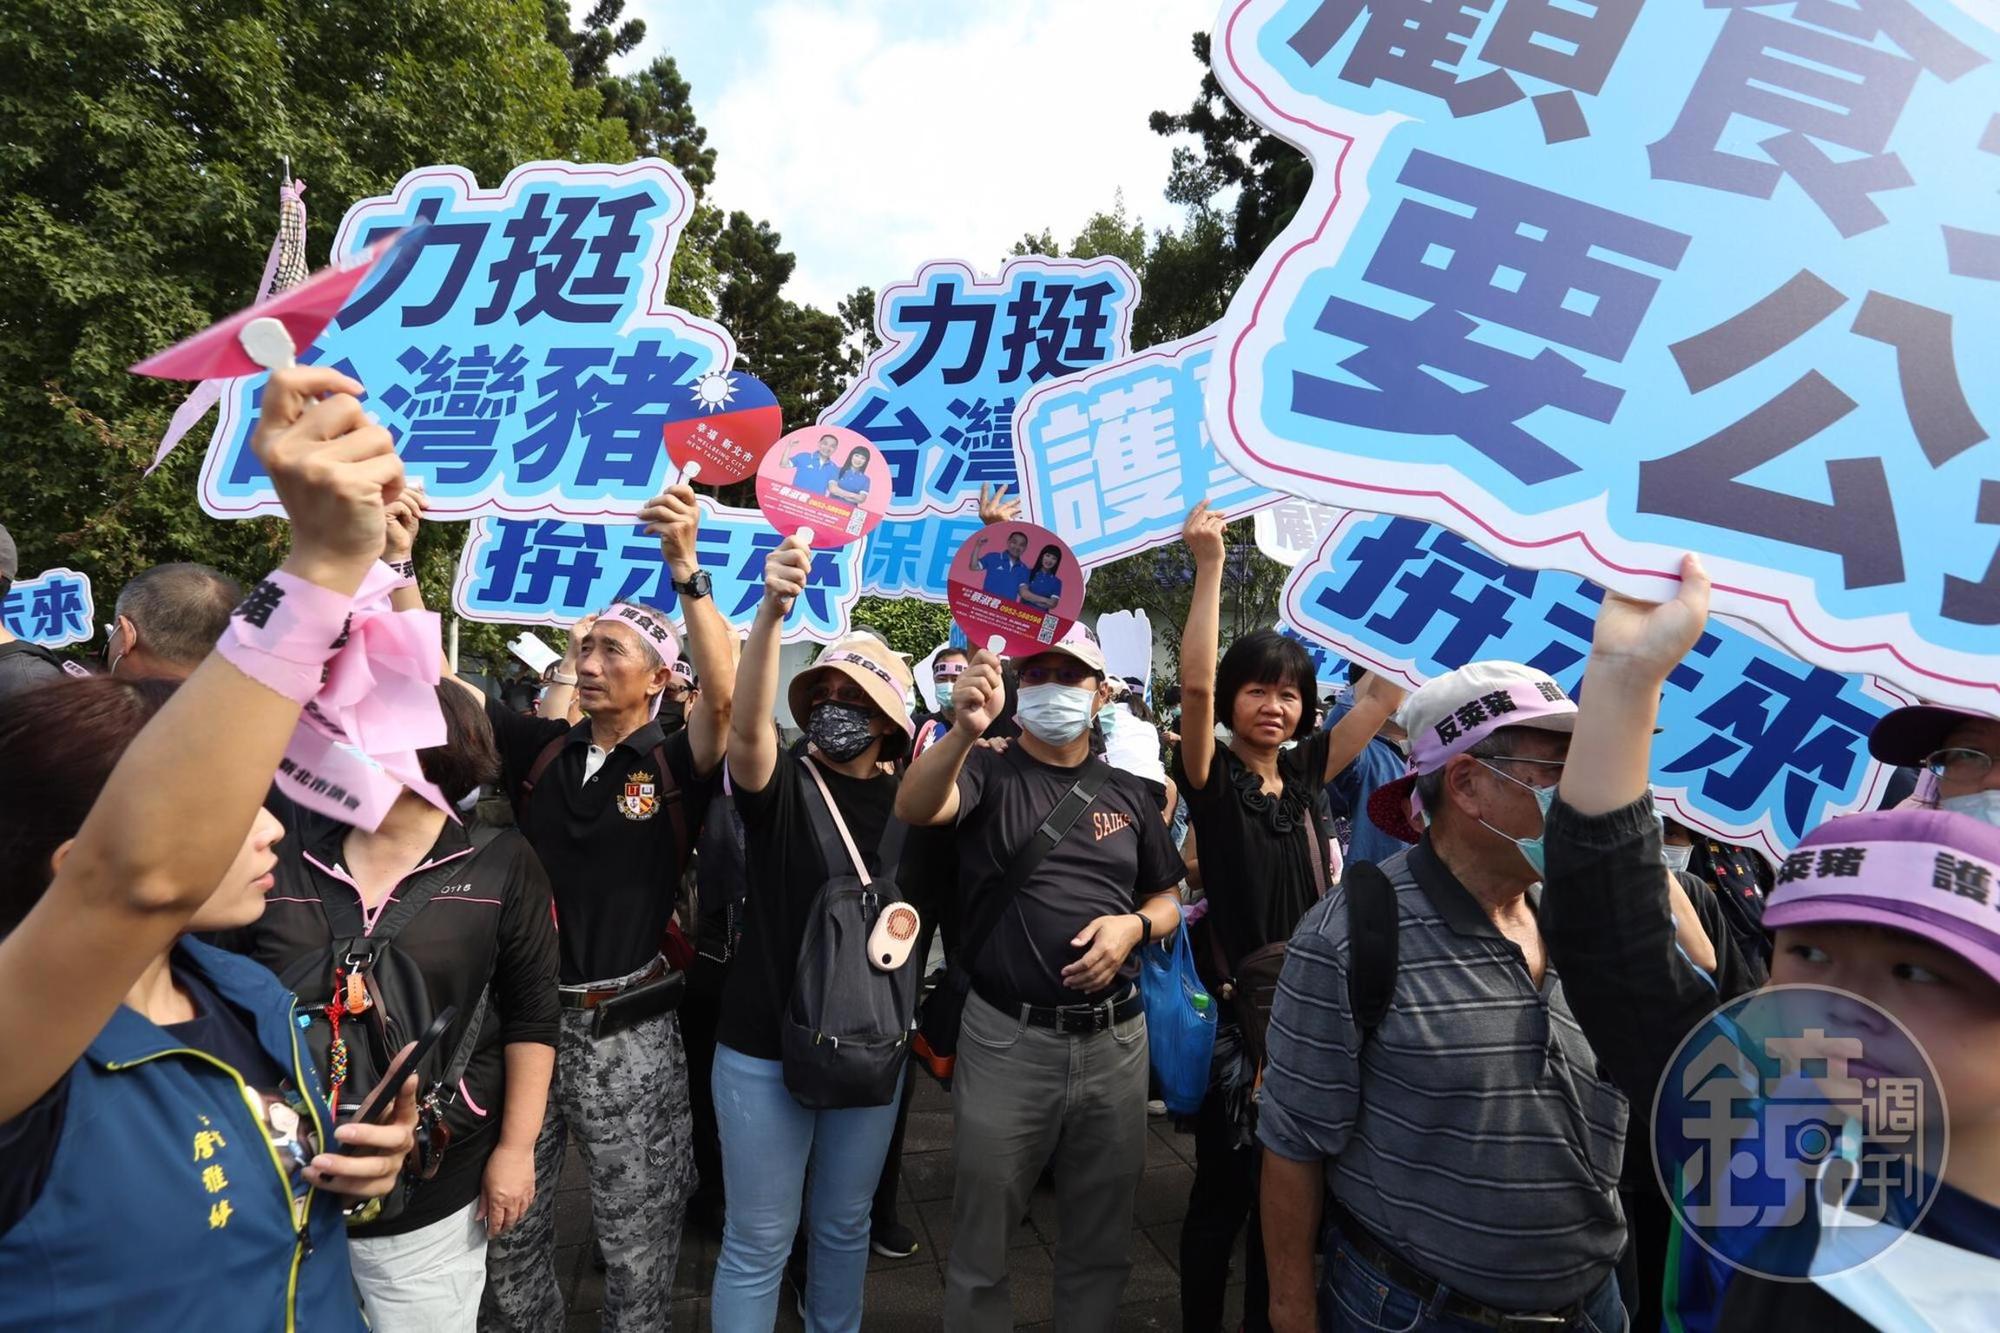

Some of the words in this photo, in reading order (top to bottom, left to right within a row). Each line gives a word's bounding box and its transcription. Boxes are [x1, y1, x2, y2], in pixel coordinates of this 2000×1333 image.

[1287, 0, 2000, 282] 顧食
[335, 191, 657, 331] 力挺
[888, 281, 1116, 388] 力挺
[1290, 148, 2000, 625] 要公
[686, 440, 701, 452] NEW
[703, 451, 724, 466] TAIPEI
[725, 464, 742, 477] CITY
[698, 437, 730, 461] WELLBEING
[731, 459, 746, 471] CITY
[722, 438, 753, 462] 新北市
[619, 607, 668, 643] 護食安
[1434, 689, 1517, 746] 反萊豬
[1932, 850, 2000, 912] 護
